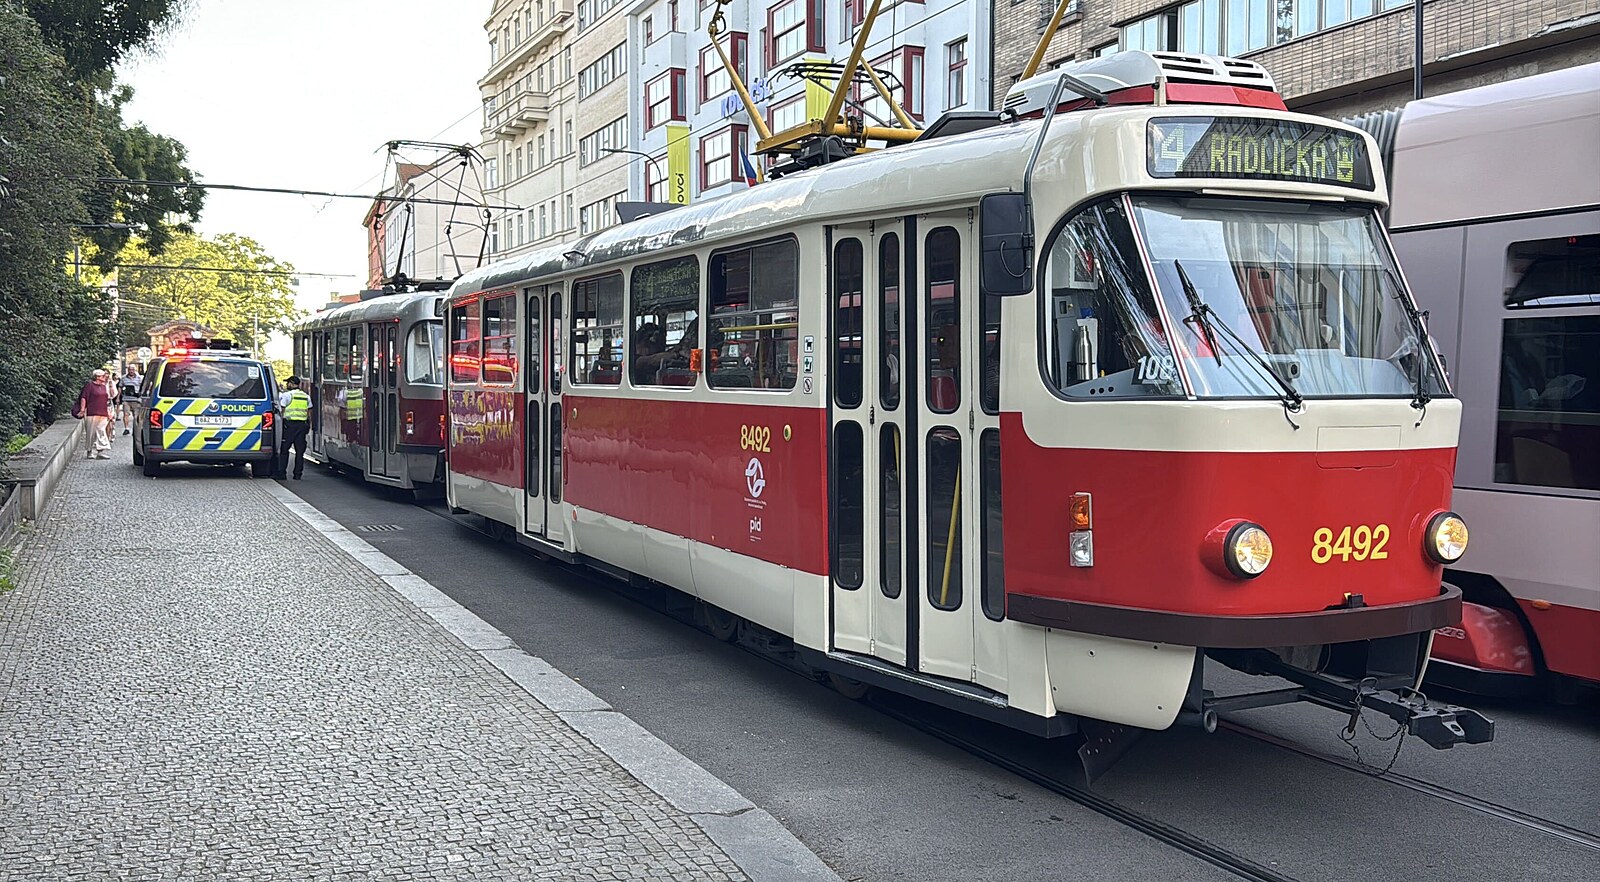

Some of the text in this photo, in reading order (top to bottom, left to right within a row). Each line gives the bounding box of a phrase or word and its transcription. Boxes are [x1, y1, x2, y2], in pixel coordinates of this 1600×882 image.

[1160, 123, 1185, 172] 4
[221, 404, 256, 412] POLICIE
[740, 424, 771, 453] 8492
[749, 516, 761, 533] pid
[1311, 523, 1390, 564] 8492
